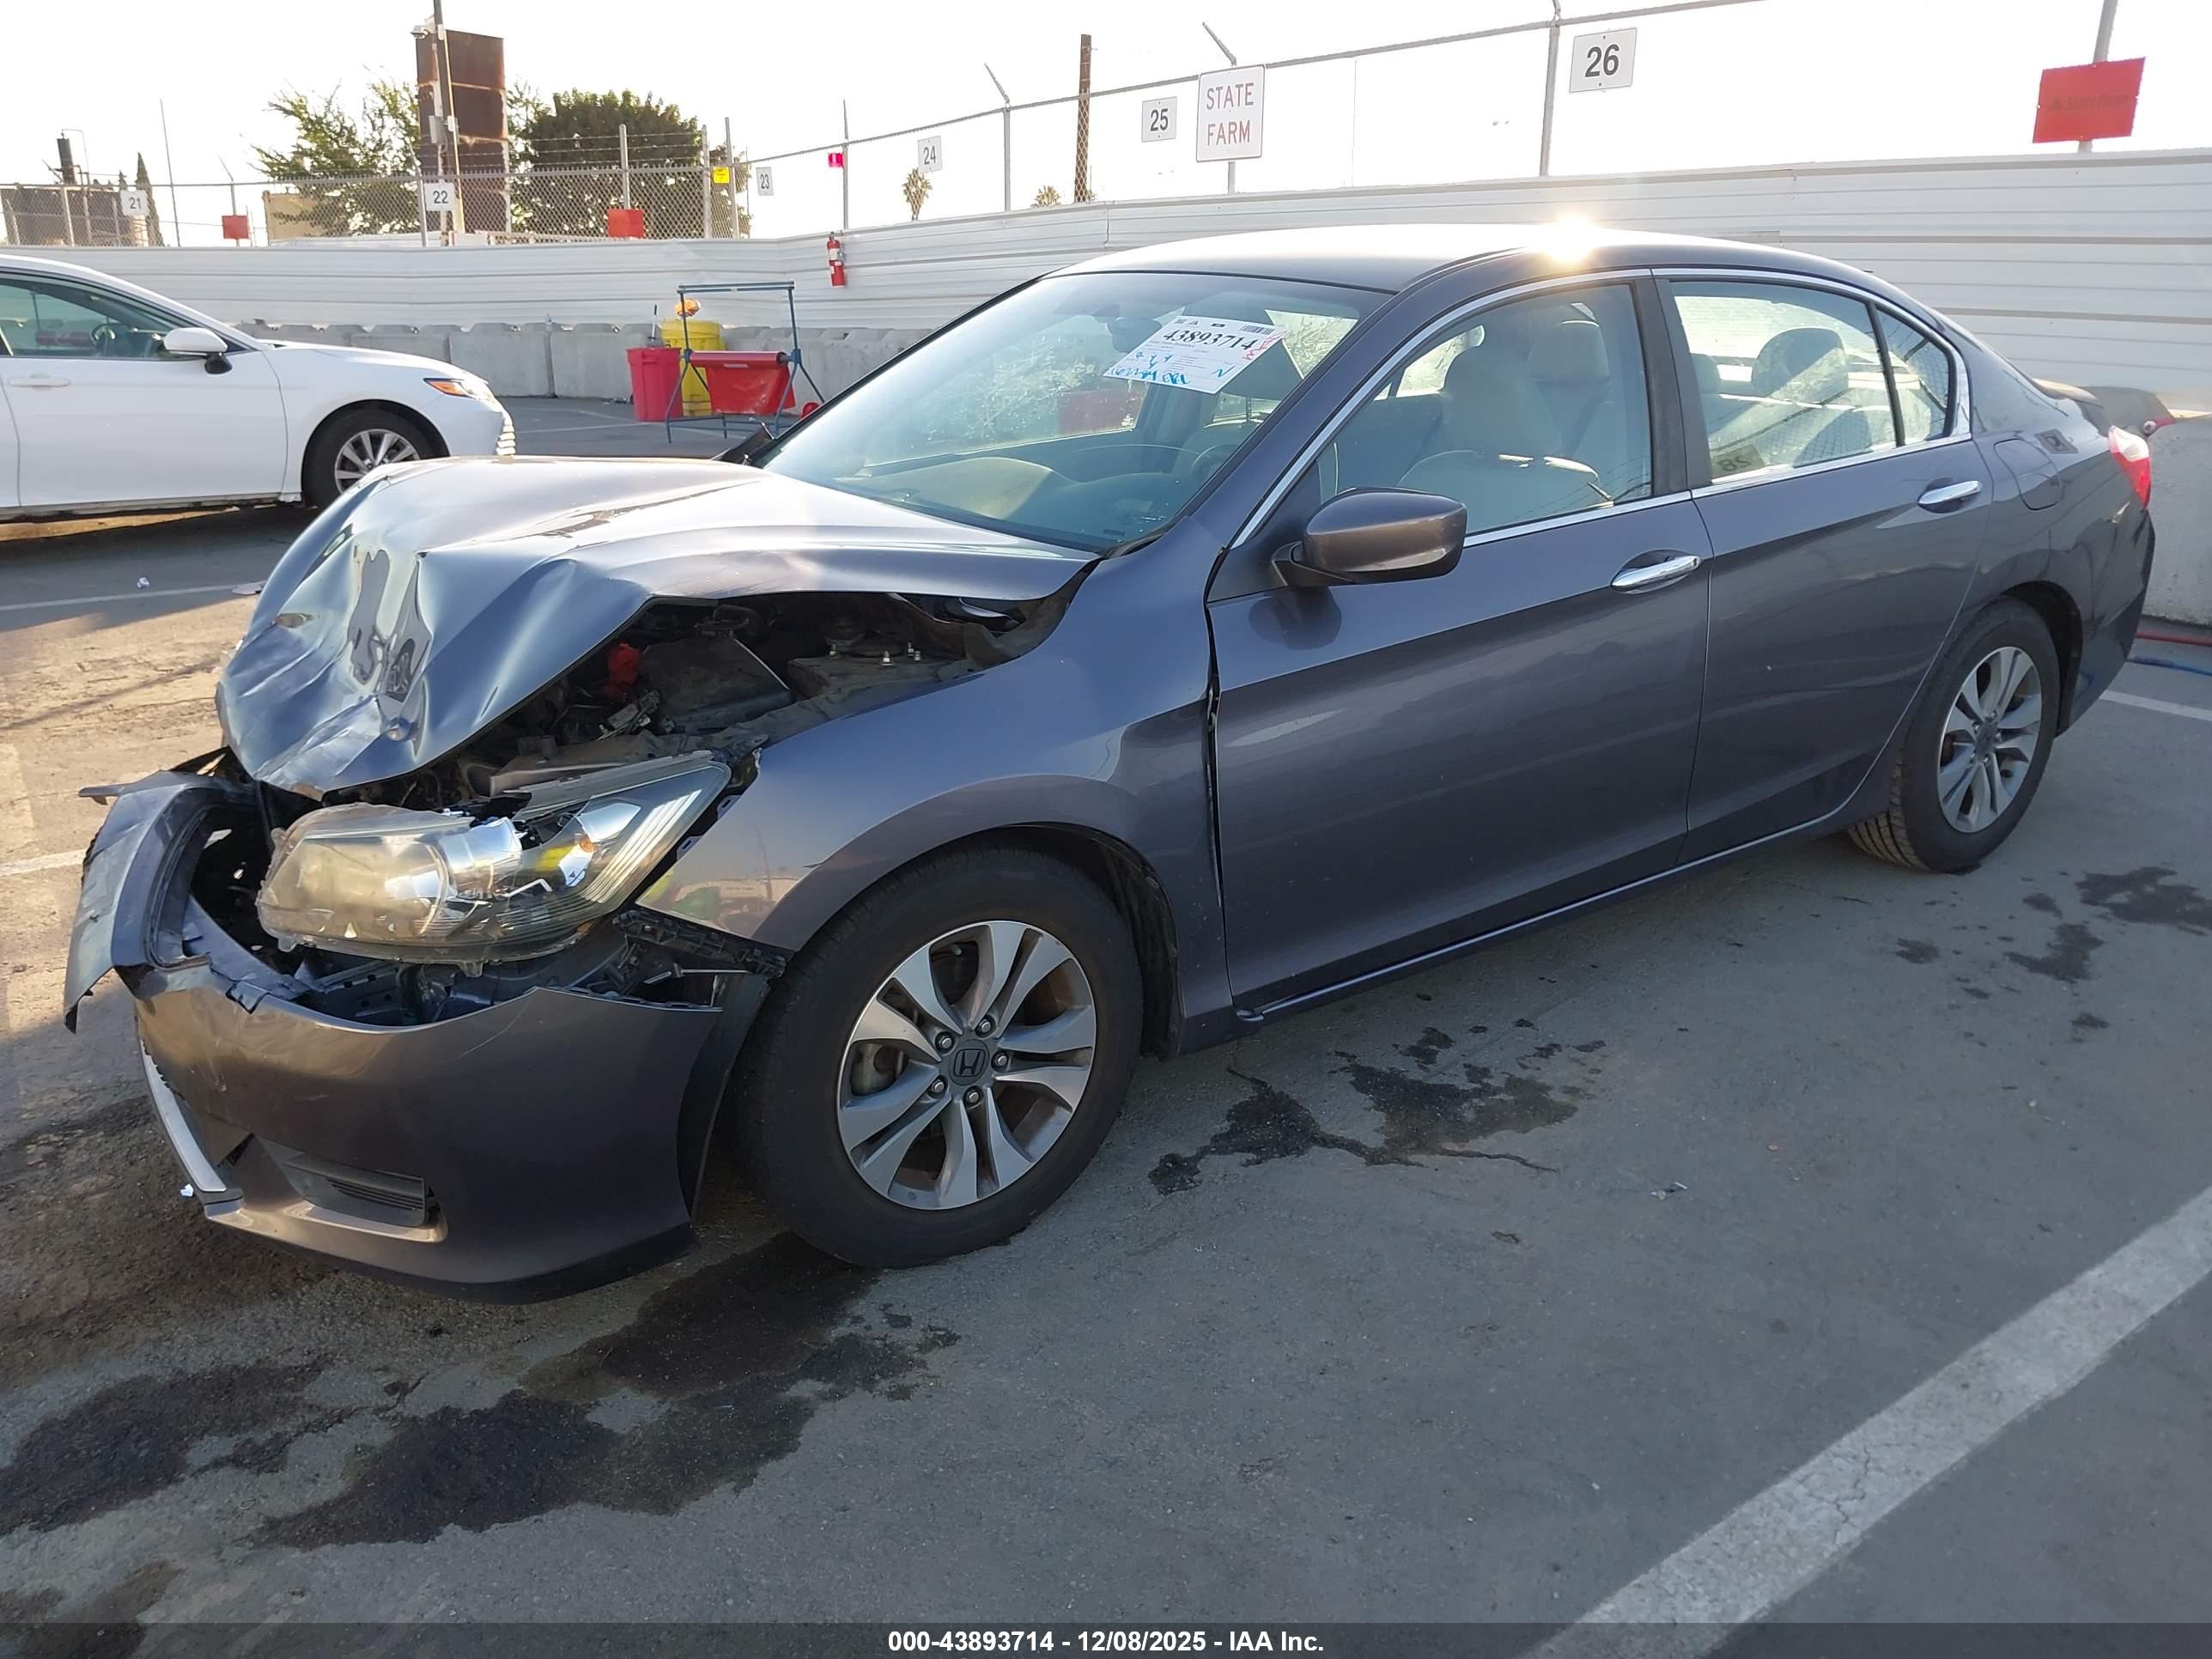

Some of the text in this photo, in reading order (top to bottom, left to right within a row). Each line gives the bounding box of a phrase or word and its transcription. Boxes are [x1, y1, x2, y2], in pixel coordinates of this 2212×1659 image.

[1585, 44, 1620, 77] 26
[1206, 82, 1254, 110] STATE
[1151, 108, 1169, 131] 25
[1207, 120, 1250, 146] FARM
[923, 146, 936, 165] 24
[760, 173, 769, 189] 23
[129, 197, 142, 209] 21
[433, 190, 449, 204] 22
[1164, 329, 1260, 350] 43893714
